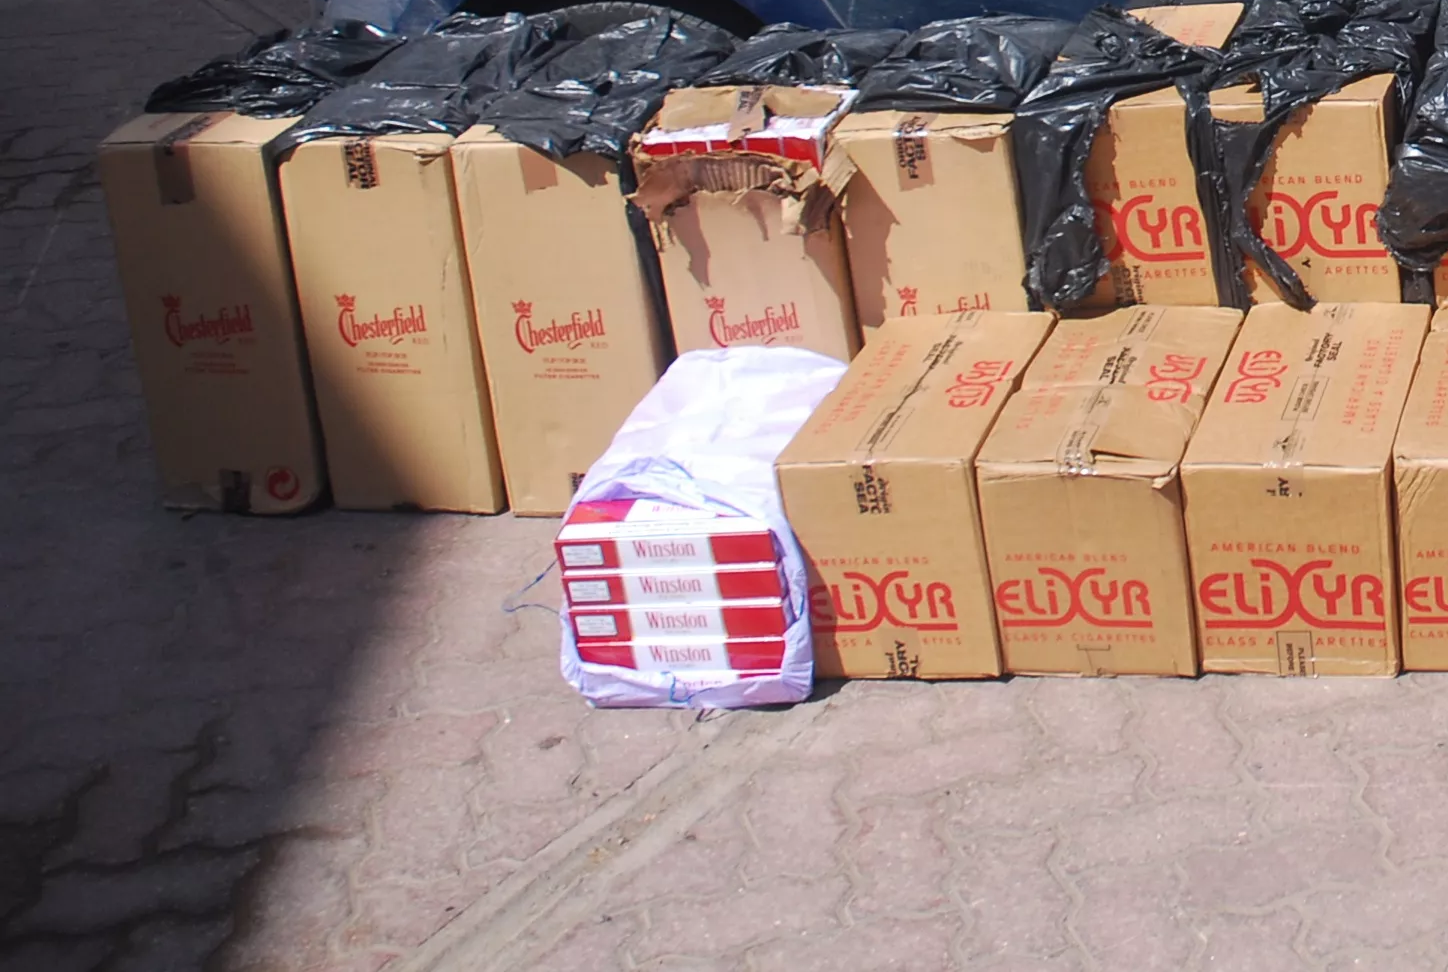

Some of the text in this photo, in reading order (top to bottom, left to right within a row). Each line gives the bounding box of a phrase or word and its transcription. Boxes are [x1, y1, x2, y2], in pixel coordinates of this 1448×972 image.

[1314, 174, 1364, 185] BLEND
[1144, 267, 1208, 279] ARETTES
[1324, 265, 1389, 276] ARETTES
[338, 304, 427, 347] Chesterfield
[515, 308, 606, 354] Chesterfield
[709, 302, 800, 348] Chesterfield
[631, 539, 697, 559] Winston
[1210, 542, 1361, 555] AMERICAN BLEND
[638, 575, 704, 595] Winston
[645, 610, 709, 630] Winston
[1206, 636, 1258, 647] CLASS
[1315, 636, 1389, 648] ARETTES
[649, 645, 713, 664] Winston
